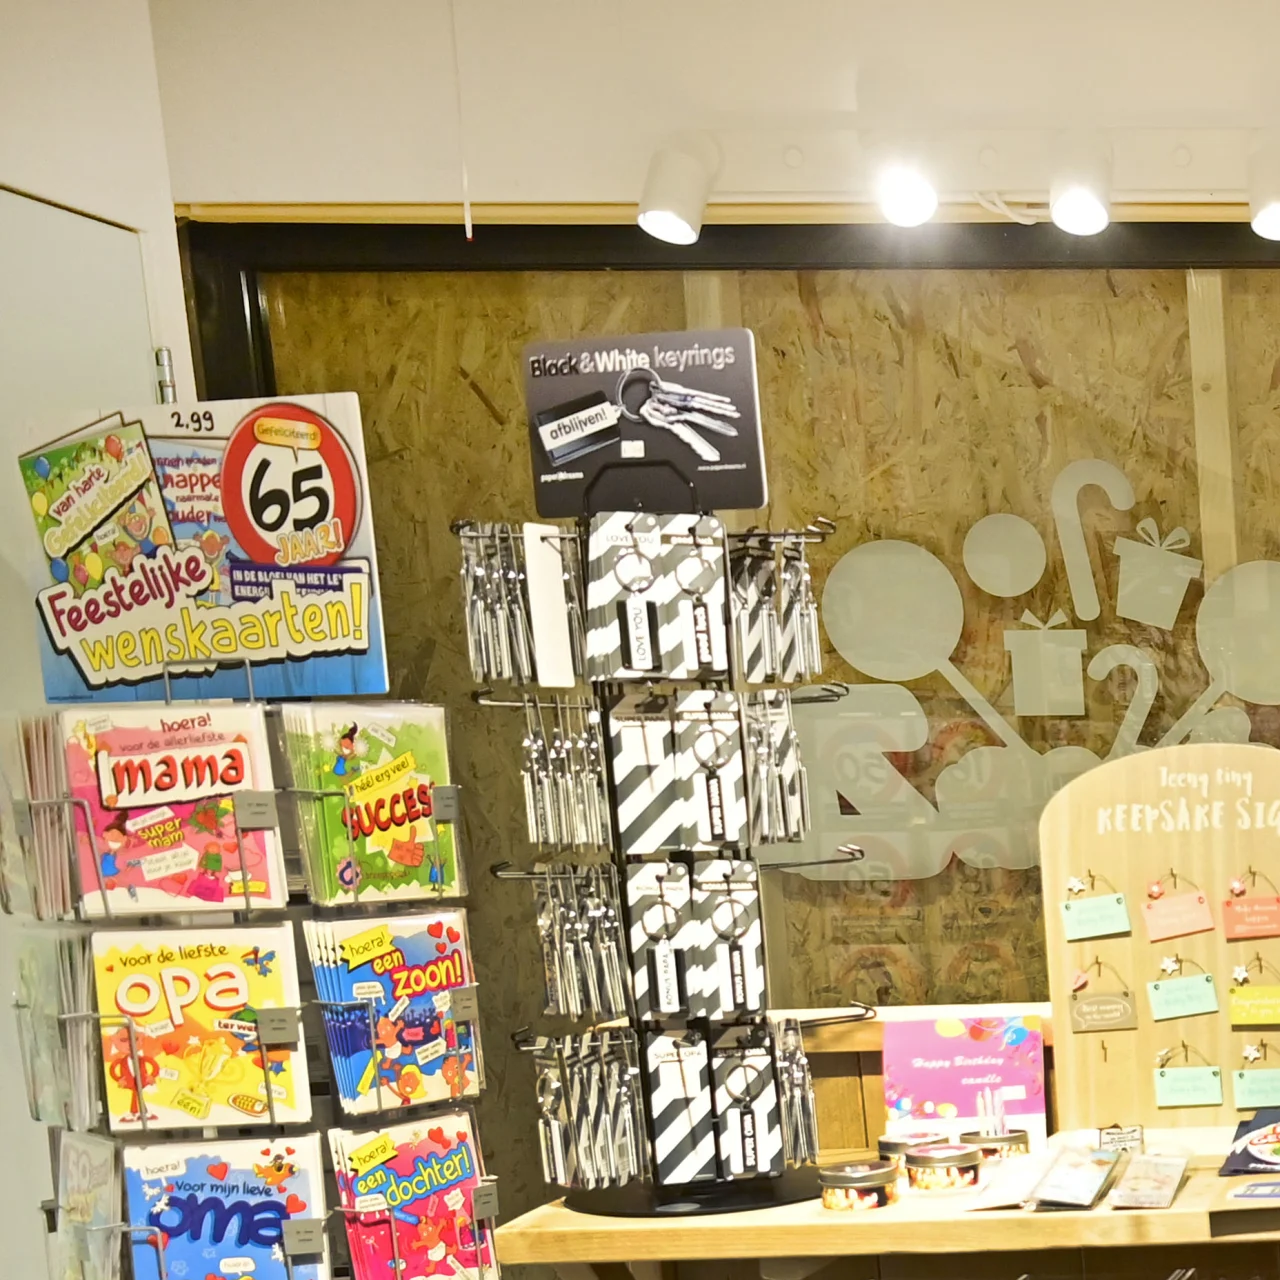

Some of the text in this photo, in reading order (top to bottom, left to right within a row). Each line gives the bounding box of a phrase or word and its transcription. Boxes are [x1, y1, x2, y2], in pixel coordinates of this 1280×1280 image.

[654, 344, 735, 371] keyrings
[170, 411, 215, 432] 2.99
[549, 407, 607, 440] afblijven!
[53, 467, 104, 518] van harte
[249, 457, 330, 532] 65
[276, 519, 344, 566] JAAR!
[233, 570, 324, 584] IN DE HET
[47, 550, 206, 637] Feestelijke
[80, 581, 363, 672] wenskaarten!
[160, 712, 212, 733] hoera!
[120, 732, 226, 752] voor de allerliefste
[111, 748, 245, 796] mama
[376, 757, 410, 784] erg veel
[1159, 767, 1253, 798] Teeny tiny
[342, 782, 435, 841] SUCCES
[1096, 798, 1225, 836] KEEPSAKE
[137, 817, 183, 840] super
[147, 830, 185, 848] mam
[119, 944, 229, 967] voor de liefste
[349, 932, 386, 957] hoera!
[373, 951, 404, 974] een
[393, 952, 463, 996] zoon!
[114, 961, 250, 1027] opa
[218, 1021, 237, 1030] ter
[912, 1055, 1004, 1069] Happy Birthday
[357, 1141, 388, 1166] hoera!
[145, 1161, 181, 1176] hoera!
[357, 1170, 387, 1194] een
[387, 1146, 471, 1206] dochter!
[210, 1180, 274, 1198] mijn lieve
[147, 1193, 291, 1249] oma
